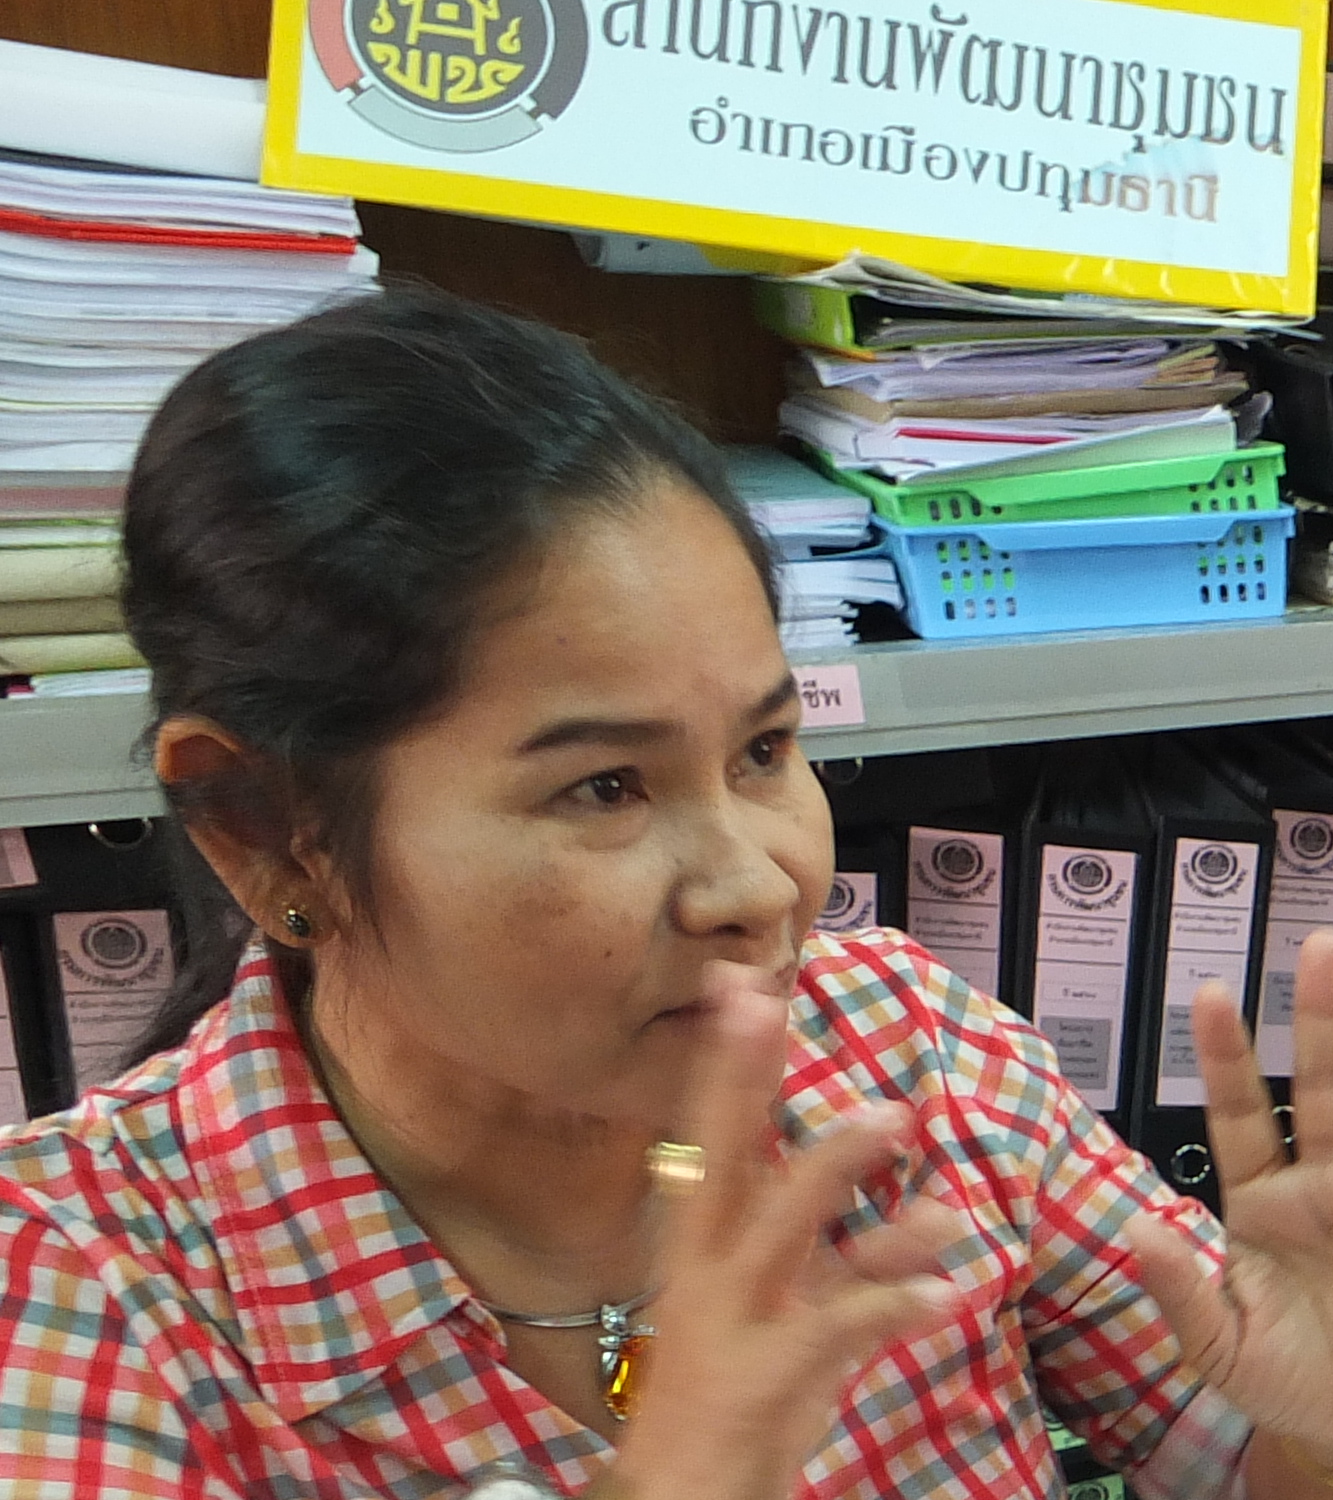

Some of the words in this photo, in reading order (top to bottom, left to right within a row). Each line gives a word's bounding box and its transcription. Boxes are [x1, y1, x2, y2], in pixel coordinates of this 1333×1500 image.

[601, 0, 1287, 157] สำนกงานพัฒนาชุมชน
